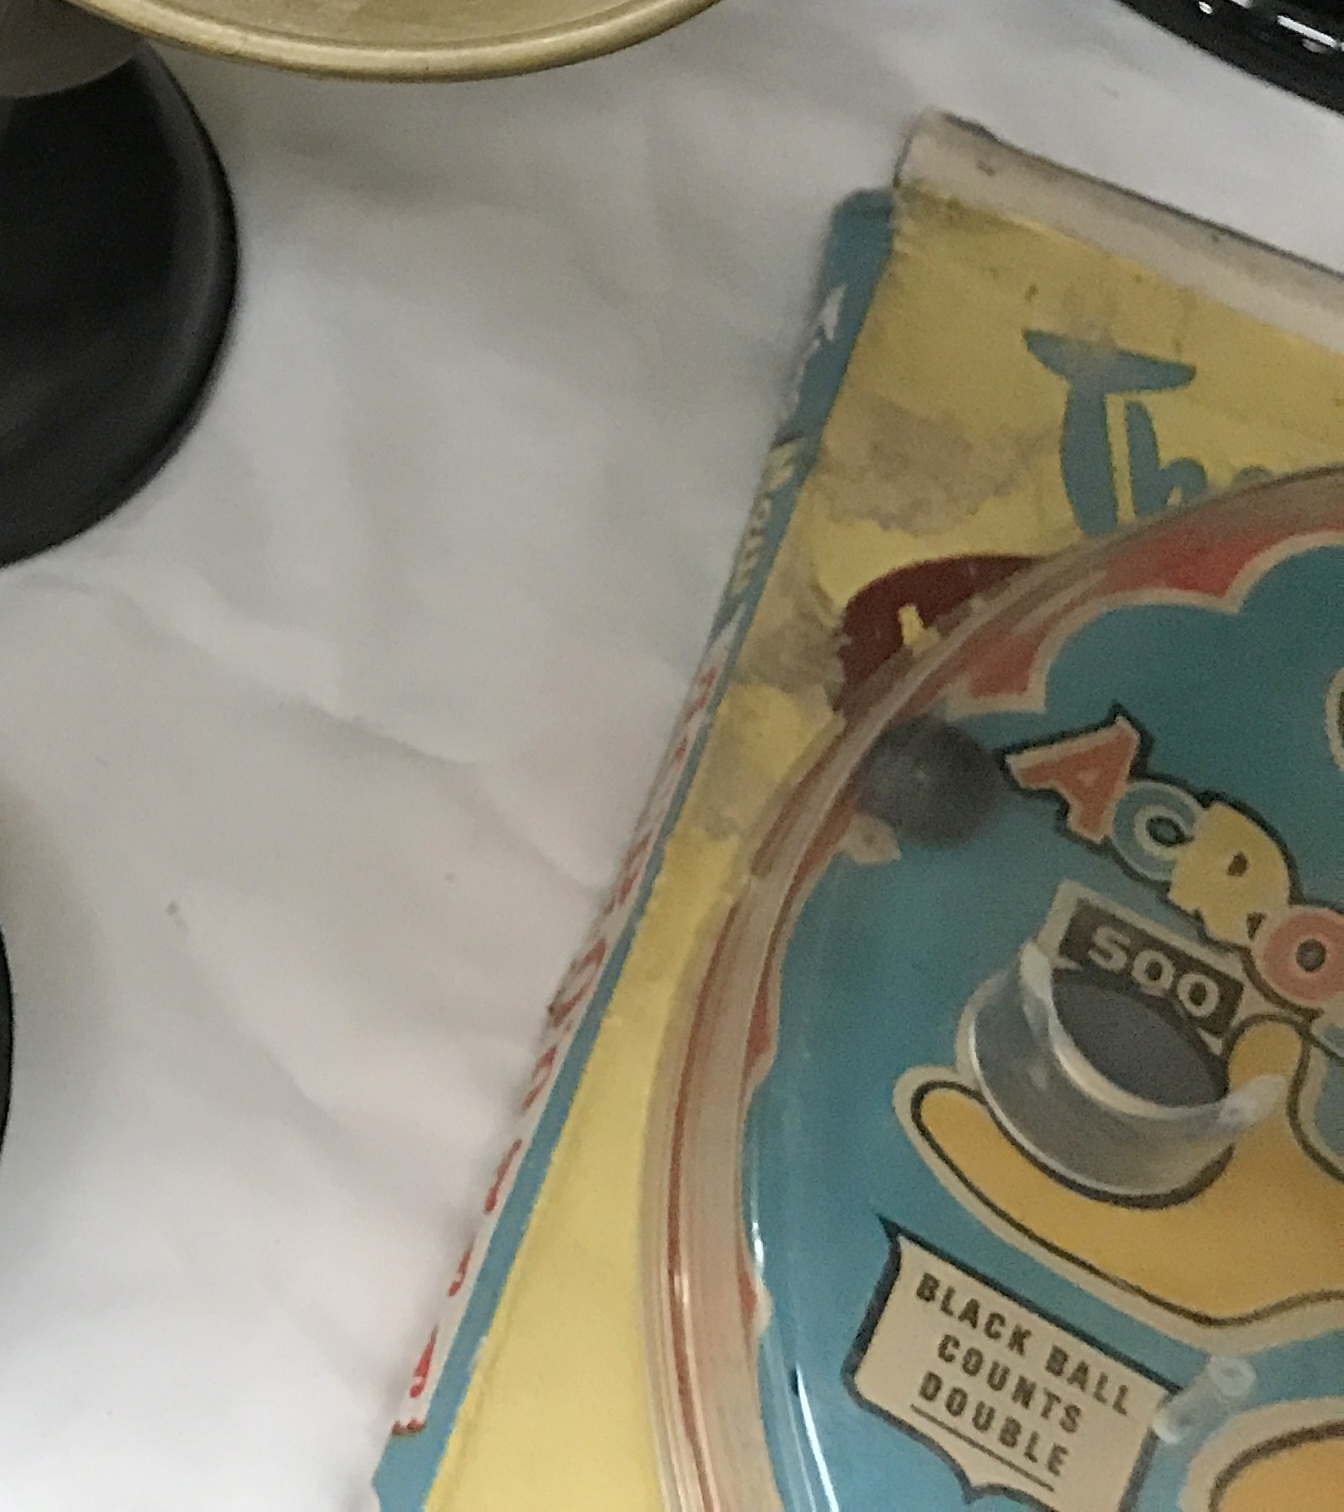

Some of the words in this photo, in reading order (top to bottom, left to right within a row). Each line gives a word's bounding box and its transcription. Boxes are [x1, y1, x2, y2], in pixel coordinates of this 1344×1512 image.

[1020, 328, 1274, 539] Th
[996, 700, 1344, 1010] ACRO
[915, 1272, 1033, 1356] BLACK
[1044, 1344, 1129, 1417] BALL
[937, 1334, 1083, 1435] COUNTS
[919, 1371, 1071, 1478] DOUBLE
